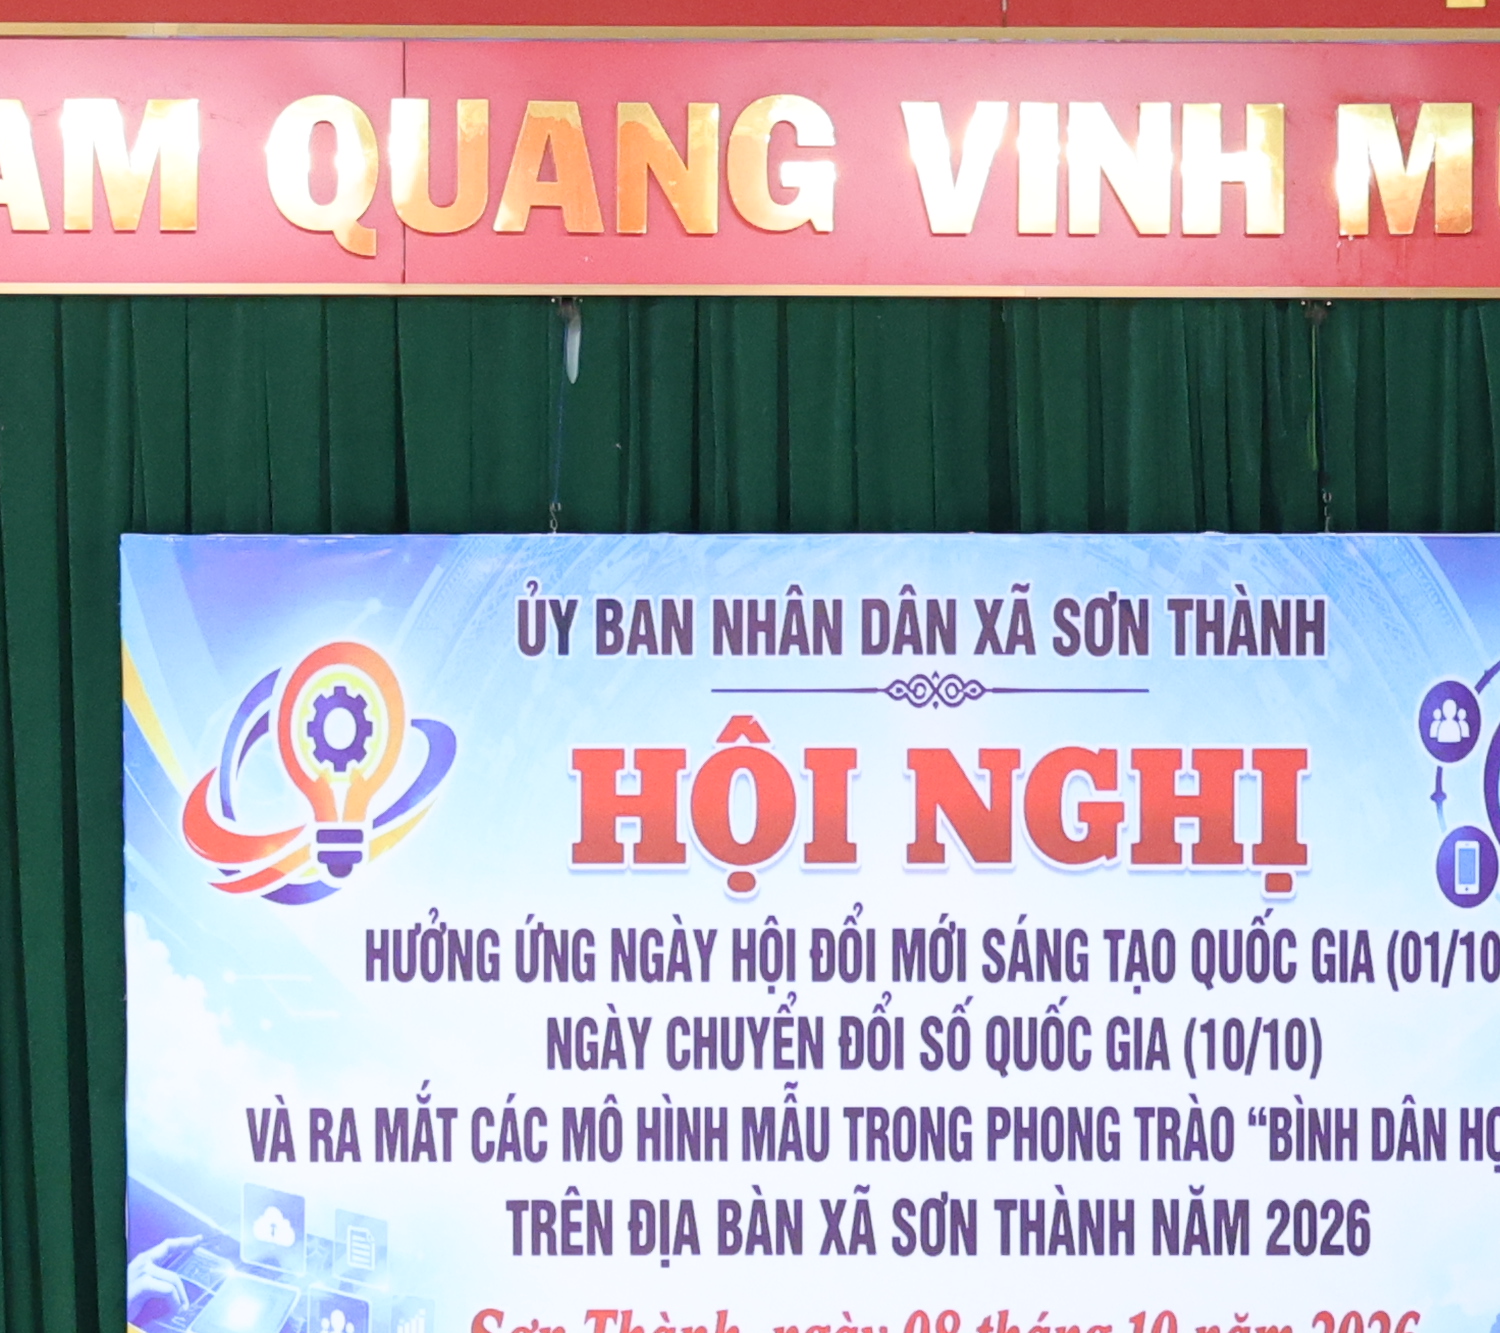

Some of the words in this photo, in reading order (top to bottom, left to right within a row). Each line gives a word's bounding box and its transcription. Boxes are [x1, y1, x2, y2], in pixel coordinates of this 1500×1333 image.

[266, 94, 836, 257] QUANG
[900, 99, 1286, 236] VINH
[519, 581, 577, 656] ỦY
[597, 599, 692, 654] BAN
[714, 585, 842, 655] NHÂN
[862, 585, 956, 654] DÂN
[975, 584, 1035, 654] XÃ
[1053, 591, 1148, 656] SƠN
[1168, 584, 1324, 655] THÀNH
[571, 715, 857, 892] HỘI
[906, 746, 1308, 892] NGHỊ
[367, 908, 499, 982] HƯỞNG
[516, 914, 594, 982] ỨNG
[612, 915, 717, 982] NGÀY
[733, 916, 796, 994] HỘI
[810, 903, 875, 982] ĐỔI
[895, 914, 966, 982] MỚI
[983, 915, 1088, 982] SÁNG
[1104, 929, 1175, 994] TẠO
[1192, 909, 1296, 990] QUỐC
[1313, 928, 1374, 983] GIA
[548, 1004, 651, 1070] NGÀY
[667, 991, 823, 1070] CHUYỂN
[839, 991, 903, 1070] ĐỔI
[921, 996, 972, 1070] SỐ
[987, 997, 1091, 1077] QUỐC
[1107, 1016, 1170, 1070] GIA
[1185, 1017, 1321, 1079] (10/10)
[247, 1095, 295, 1161] VÀ
[310, 1108, 360, 1161] RA
[376, 1080, 457, 1161] MẮT
[472, 1094, 547, 1162] CÁC
[561, 1094, 623, 1162] MÔ
[638, 1094, 727, 1161] HÌNH
[743, 1082, 829, 1161] MẪU
[844, 1107, 971, 1162] TRONG
[988, 1107, 1120, 1161] PHONG
[1134, 1094, 1234, 1161] TRÀO
[1249, 1095, 1357, 1161] “BÌNH
[1372, 1095, 1446, 1161] DÂN
[507, 1186, 612, 1255] TRÊN
[628, 1200, 700, 1267] ĐỊA
[718, 1185, 802, 1255] BÀN
[820, 1185, 876, 1254] XÃ
[893, 1192, 976, 1256] SƠN
[995, 1185, 1134, 1255] THÀNH
[1153, 1186, 1249, 1255] NĂM
[1267, 1199, 1370, 1256] 2026
